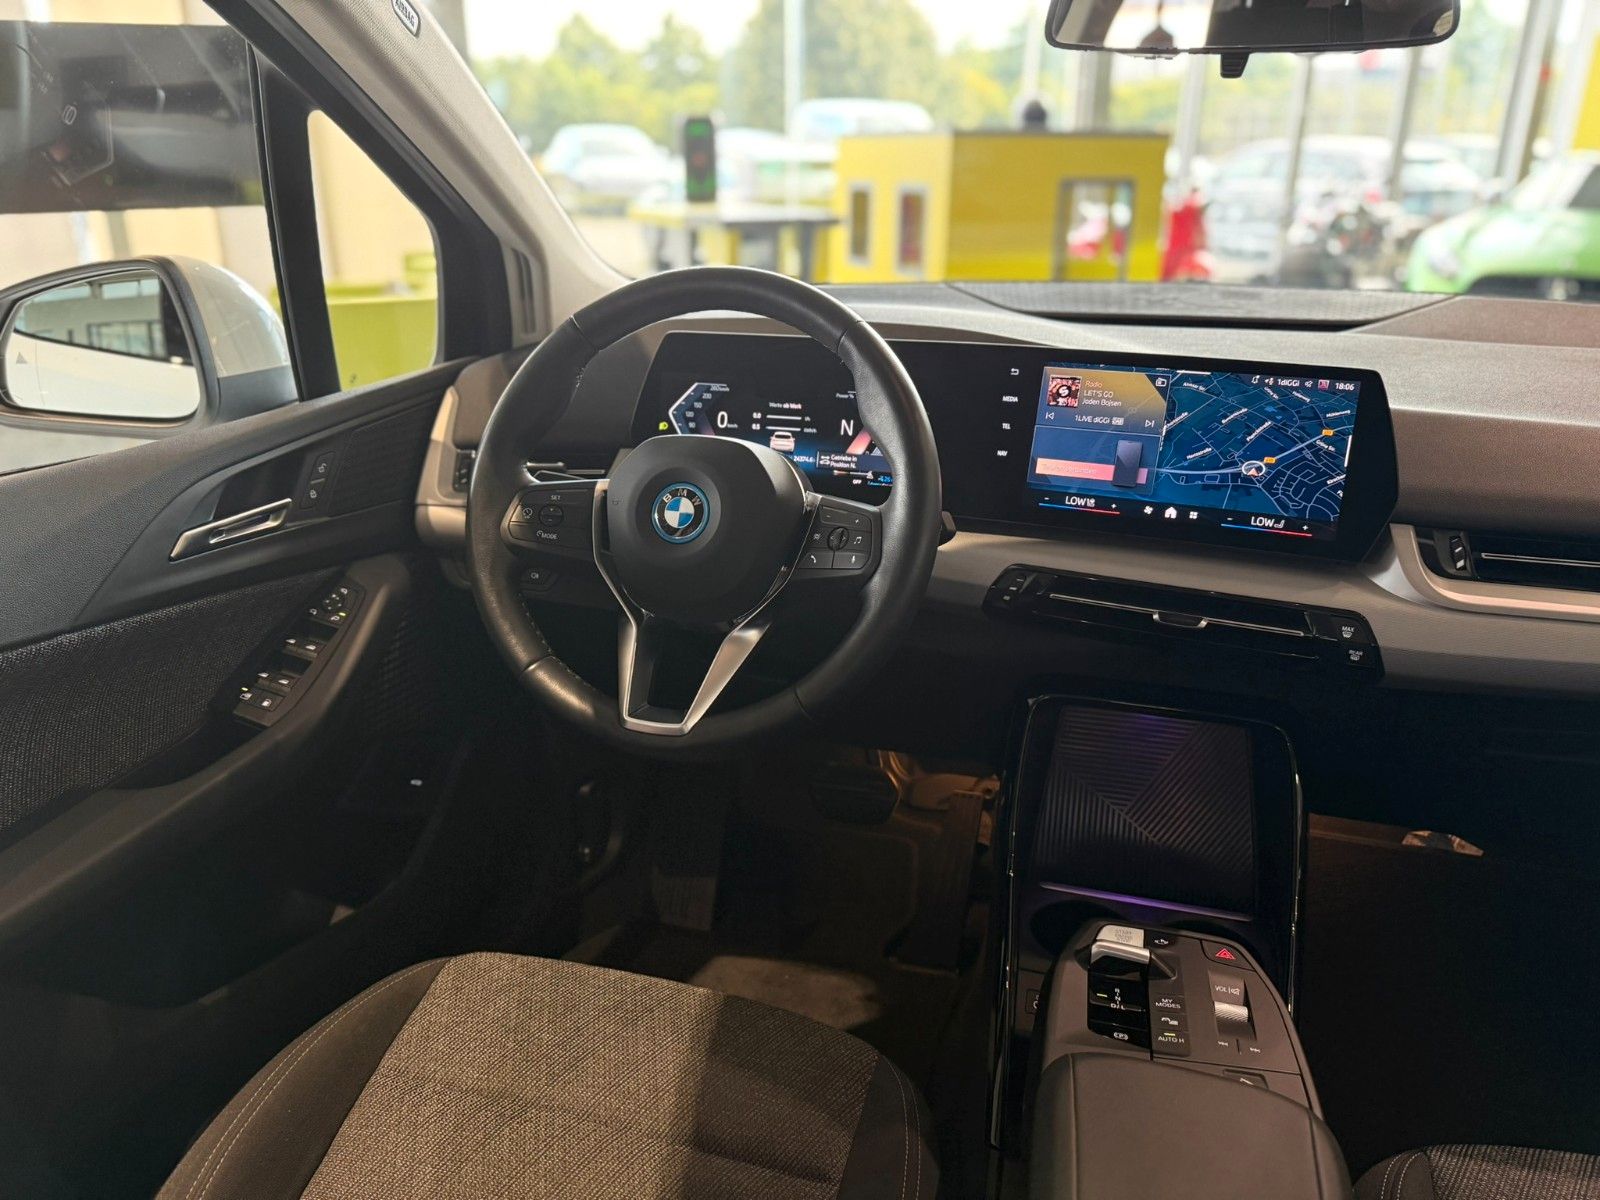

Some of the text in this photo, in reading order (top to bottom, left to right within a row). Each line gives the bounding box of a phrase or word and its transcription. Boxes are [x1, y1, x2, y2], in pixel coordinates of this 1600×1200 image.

[1335, 382, 1355, 391] 18:06
[717, 411, 728, 428] 0
[840, 419, 854, 436] N
[663, 488, 701, 506] BMW
[1065, 496, 1275, 528] LOW LOW
[1214, 985, 1227, 993] VOL
[1158, 1035, 1178, 1043] AUTO
